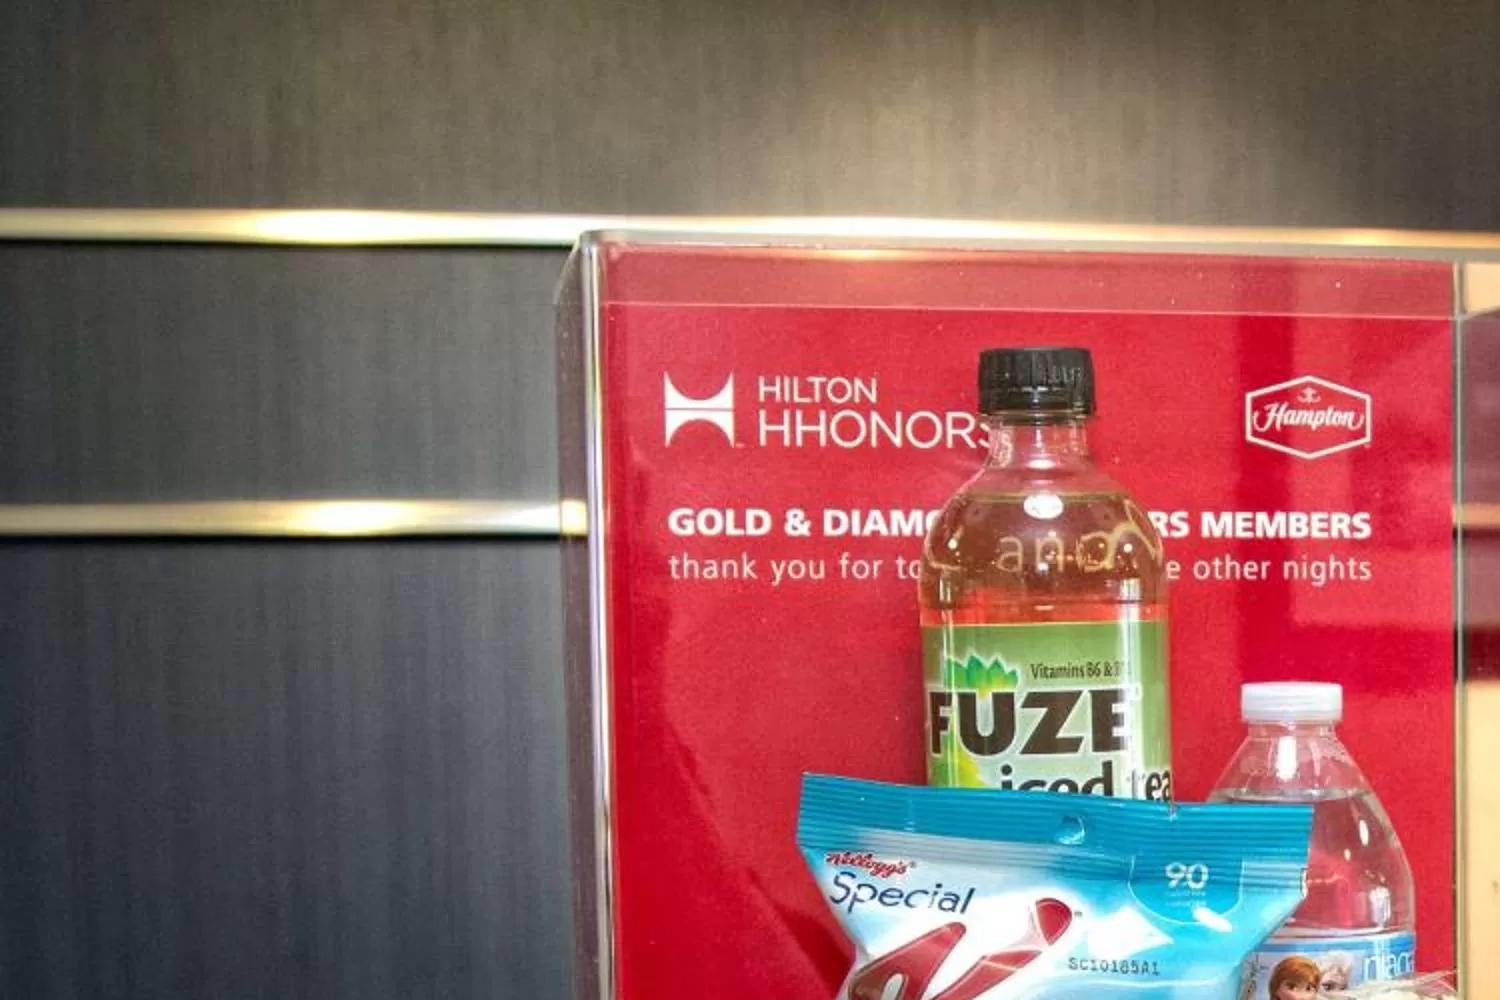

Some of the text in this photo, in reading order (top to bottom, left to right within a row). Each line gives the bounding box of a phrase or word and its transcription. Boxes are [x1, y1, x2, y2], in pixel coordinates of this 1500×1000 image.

[758, 376, 878, 404] HILTON
[1252, 401, 1364, 432] Hampton
[668, 508, 772, 537] GOLD
[784, 508, 811, 537] &
[1201, 511, 1372, 539] MEMBERS
[668, 553, 757, 581] thank
[771, 558, 825, 586] you
[840, 553, 884, 581] for
[1192, 553, 1271, 580] other
[1283, 553, 1372, 587] nights
[1030, 661, 1085, 679] Vitamins
[930, 686, 1129, 757] FUZE
[1165, 861, 1209, 889] 90
[830, 871, 976, 914] Special
